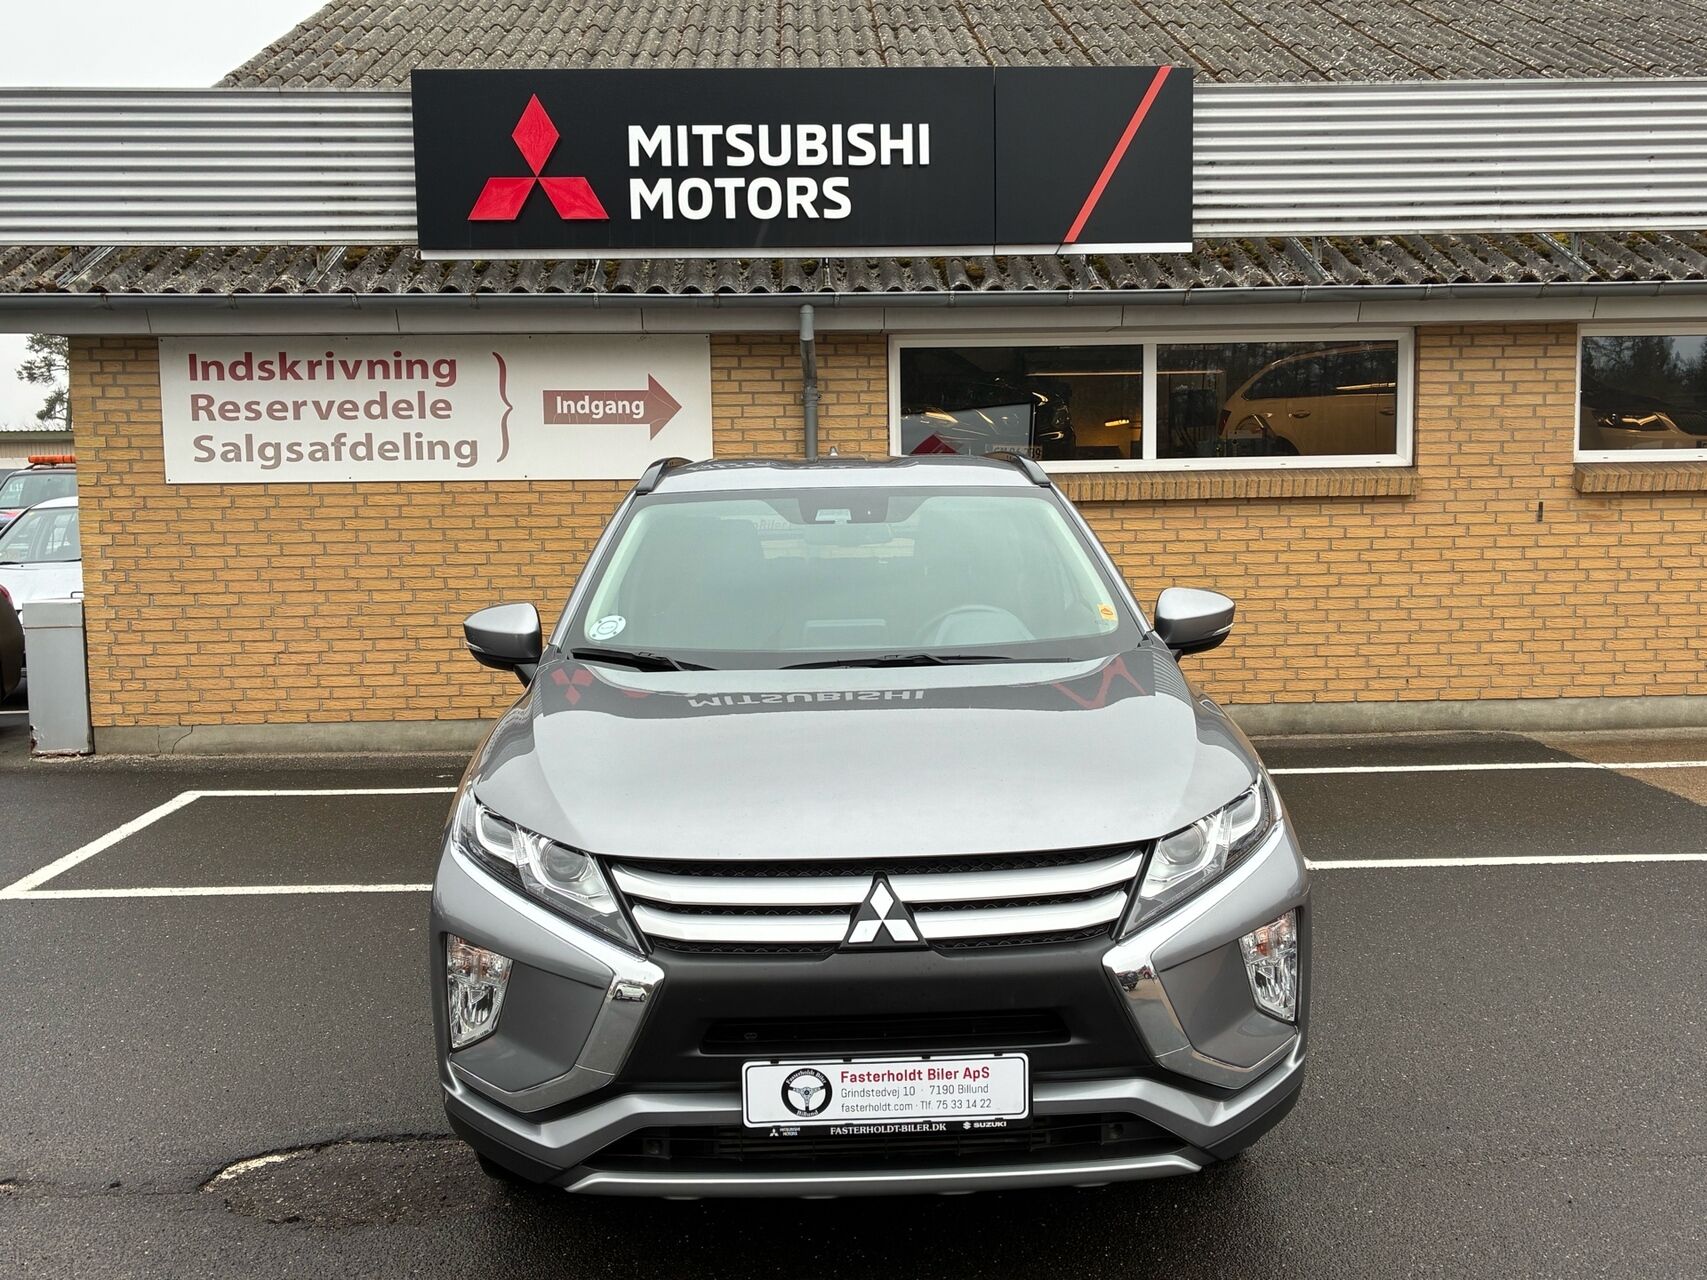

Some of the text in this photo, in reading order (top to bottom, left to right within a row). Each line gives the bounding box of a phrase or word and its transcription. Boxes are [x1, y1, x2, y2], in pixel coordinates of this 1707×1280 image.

[628, 123, 930, 167] MITSUBISHI
[629, 176, 851, 220] MOTORS
[188, 350, 457, 387] Indskrivning
[190, 390, 453, 422] Reservedele
[556, 395, 645, 419] Indgang
[193, 432, 479, 470] Salgsafdeling
[841, 1066, 990, 1083] Fasterholdt Biler ApS
[841, 1083, 989, 1099] Grindstedvej 10 7190 Billund
[841, 1098, 992, 1112] fasterholdt.com Tlf. 75 33 14 22
[830, 1122, 947, 1135] FASTERHOLDT-BILER.DK
